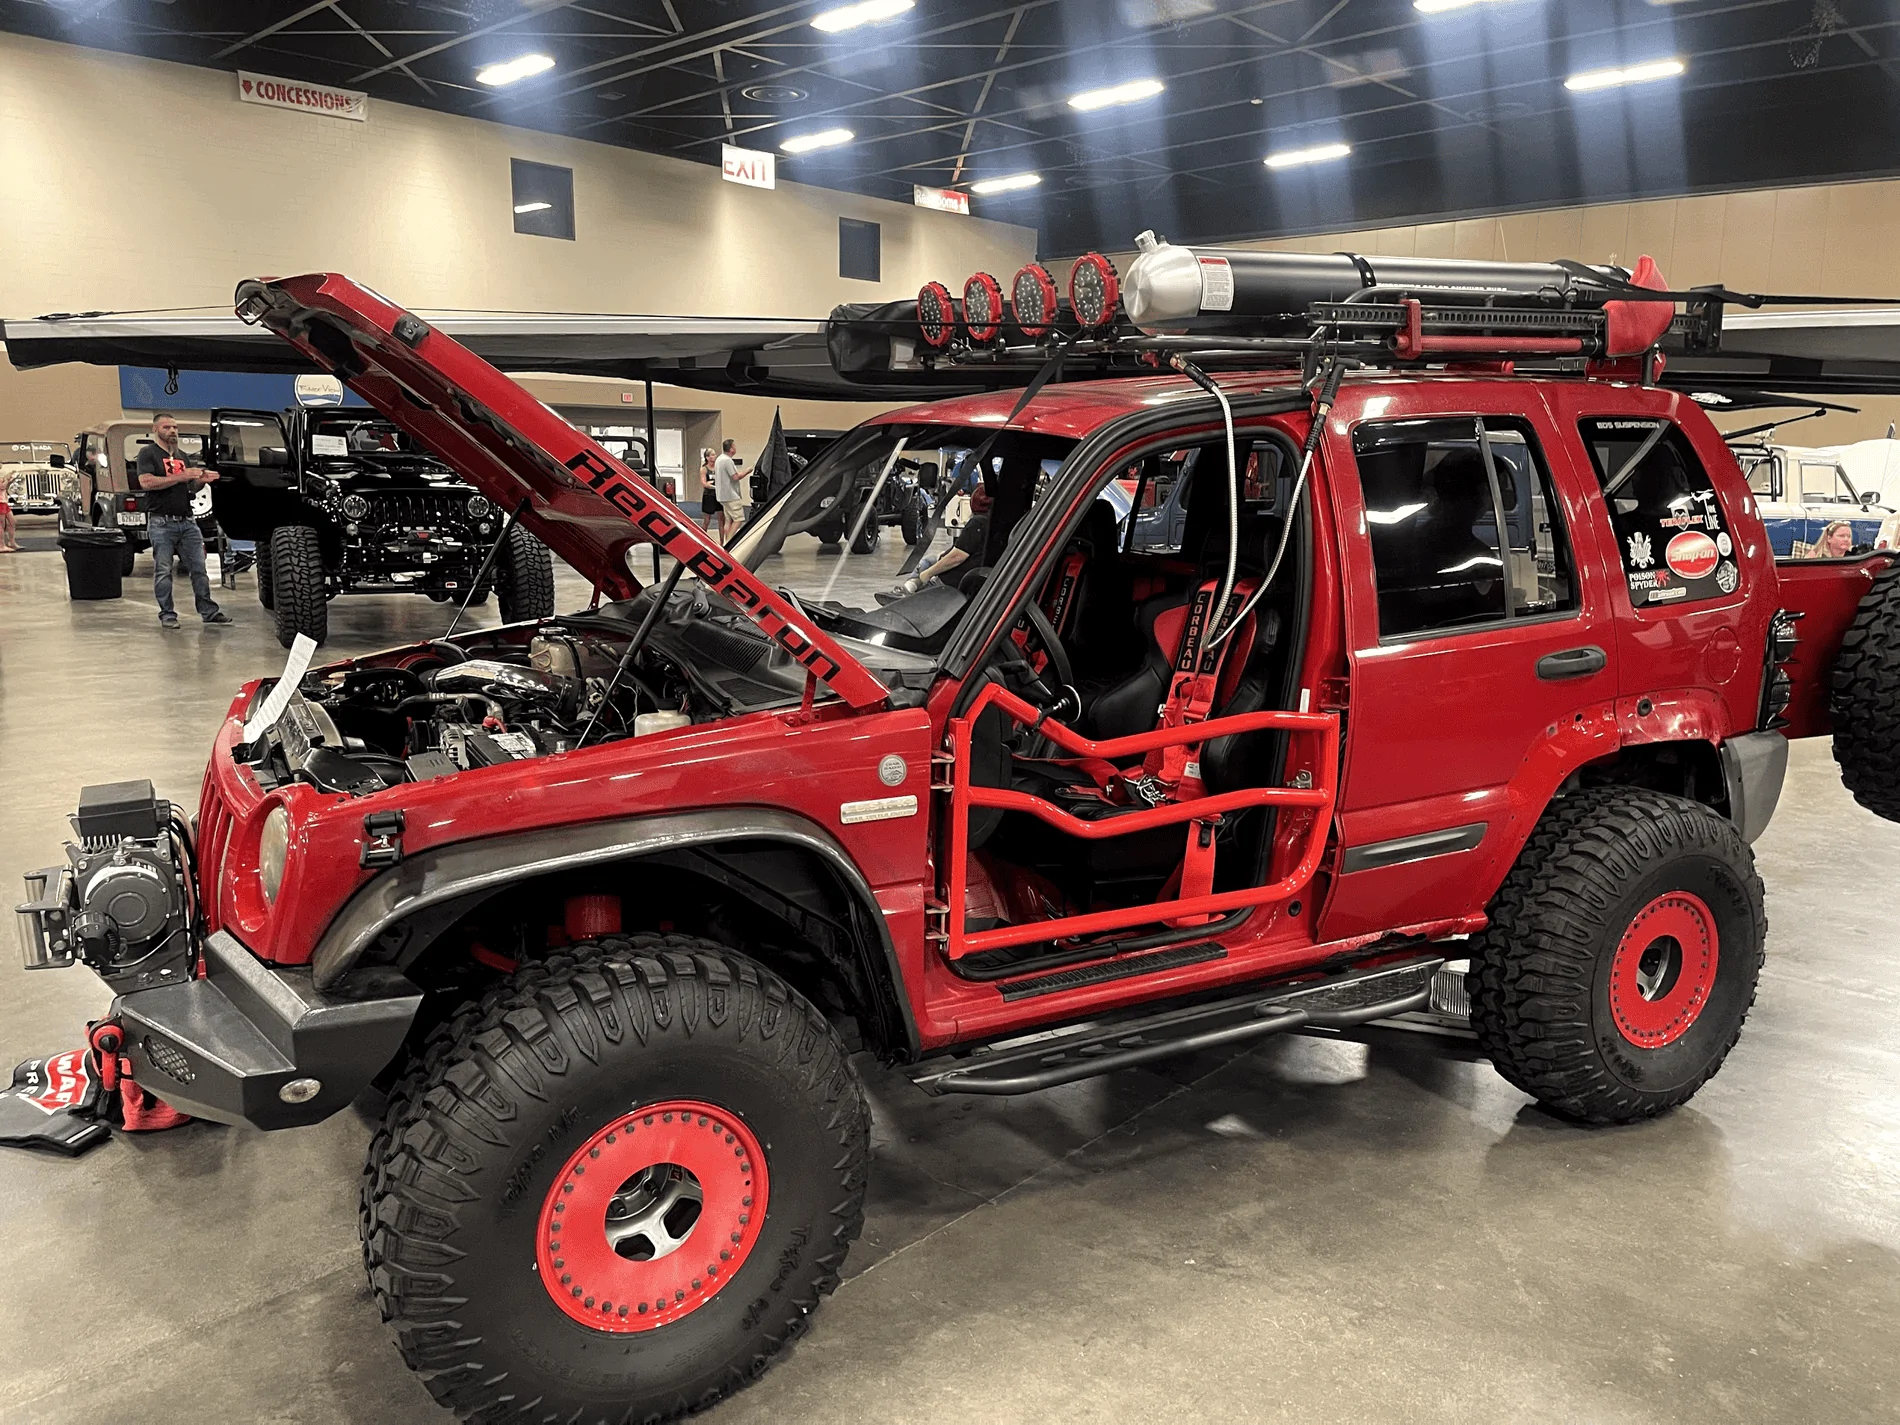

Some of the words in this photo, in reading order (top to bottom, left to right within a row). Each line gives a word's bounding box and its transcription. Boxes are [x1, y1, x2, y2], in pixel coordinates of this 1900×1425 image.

[256, 81, 352, 113] CONCESSIONS
[564, 449, 685, 547] Red
[685, 550, 842, 683] Baron
[1629, 571, 1656, 581] POISON
[1630, 579, 1660, 590] SPYDER
[1181, 593, 1206, 670] CORBEAU
[1203, 596, 1238, 671] CORBAU
